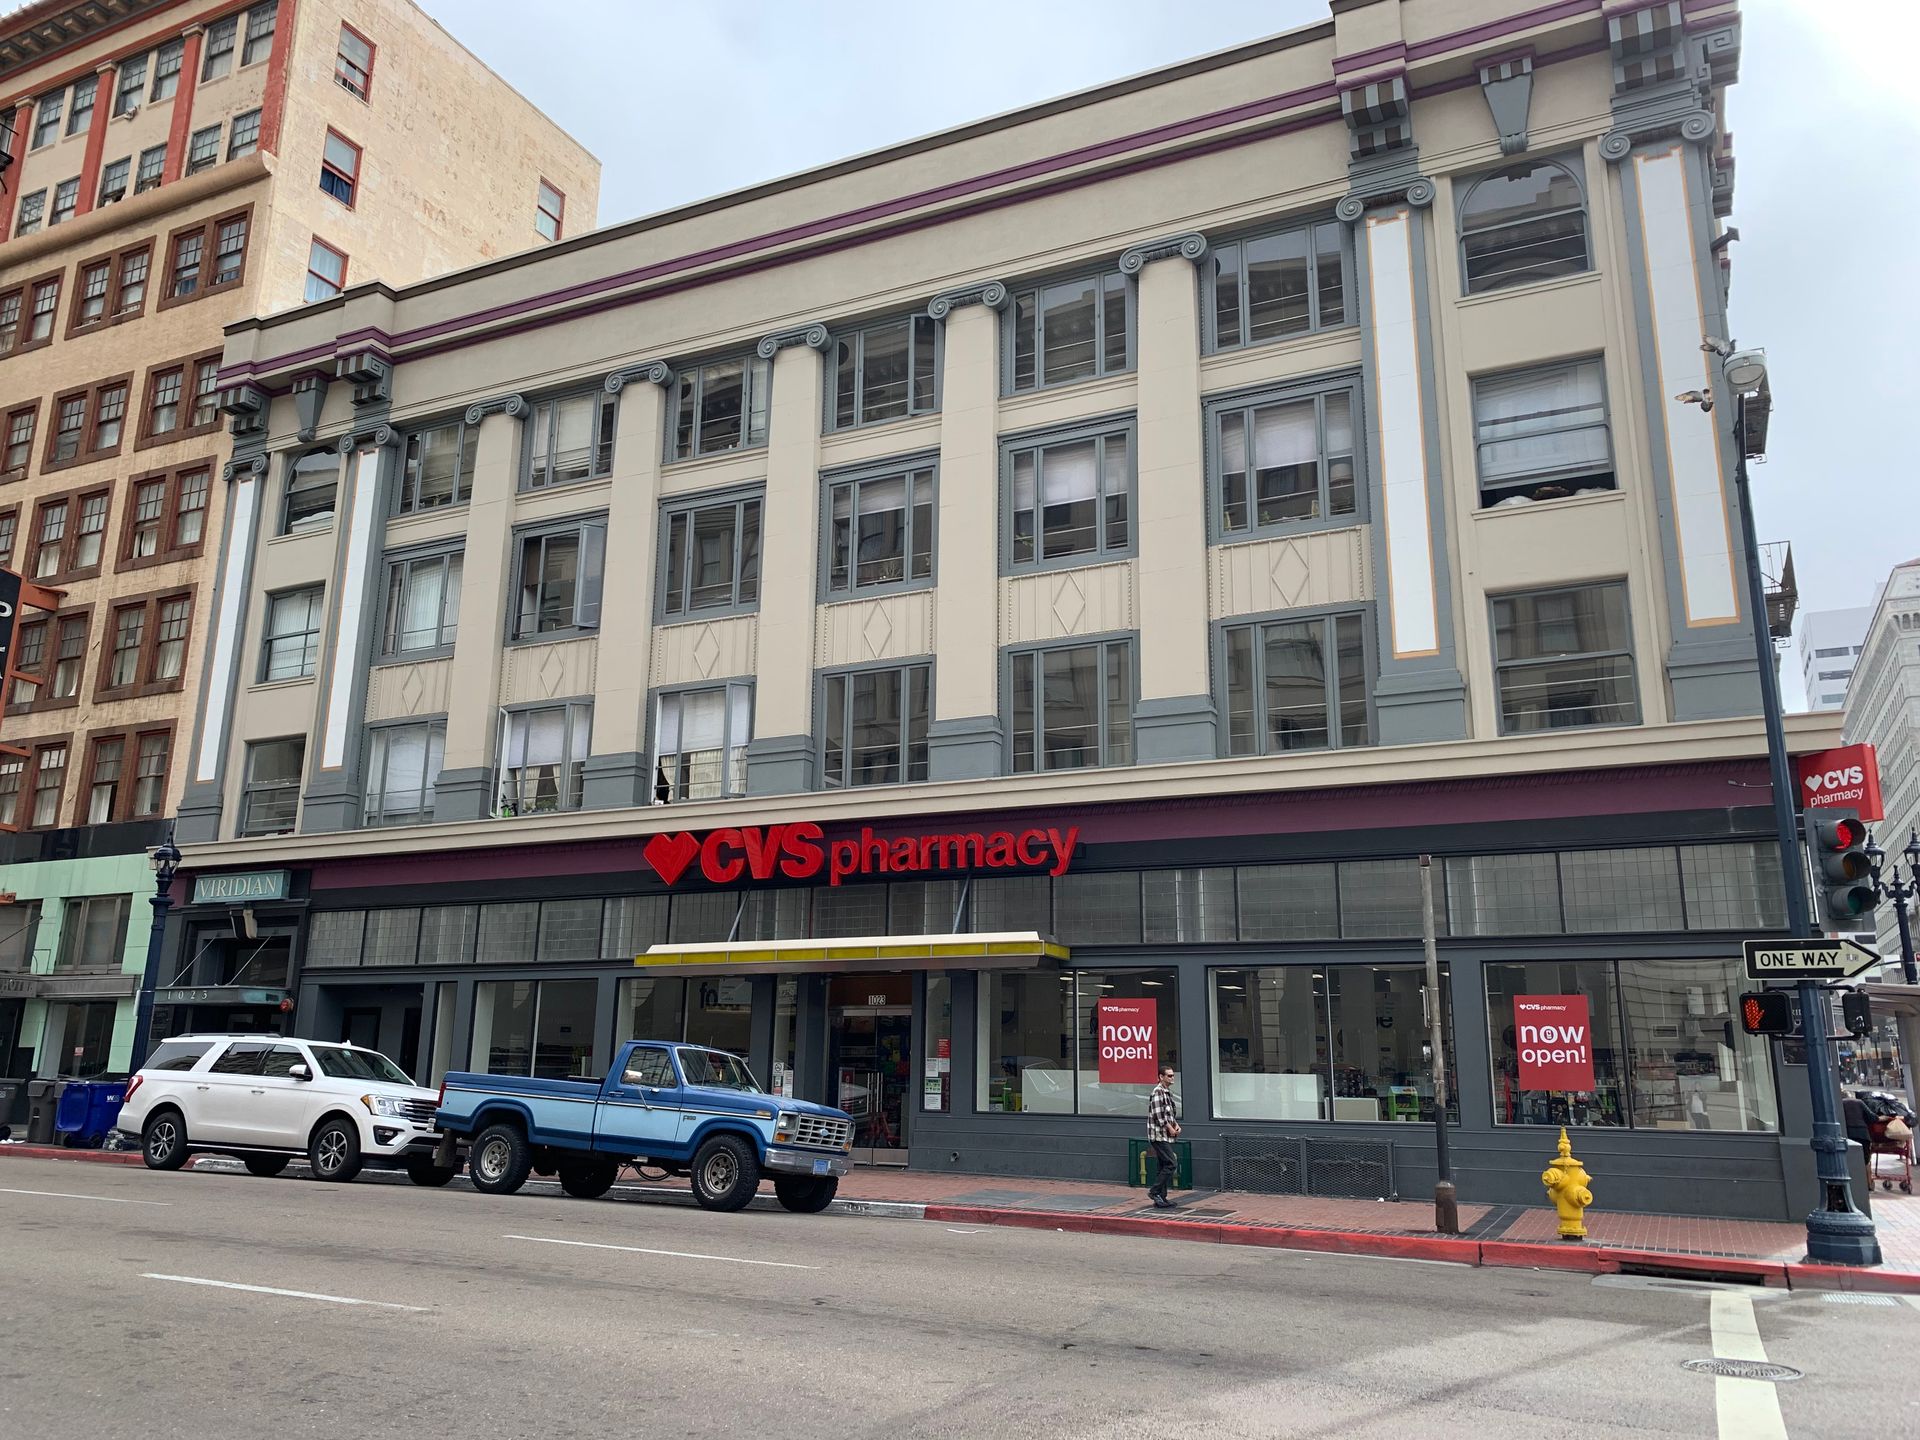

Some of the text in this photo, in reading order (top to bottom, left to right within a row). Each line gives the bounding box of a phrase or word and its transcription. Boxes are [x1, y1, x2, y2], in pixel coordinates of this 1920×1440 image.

[1824, 765, 1863, 789] CVS
[1810, 788, 1864, 809] pharmacy
[700, 822, 1080, 887] CVS pharmacy
[200, 875, 277, 897] VIRIDIAN
[1760, 952, 1796, 967] ONE
[1801, 951, 1838, 966] WAY
[167, 991, 208, 1000] 1023
[868, 995, 886, 1005] 1023
[1102, 1025, 1153, 1042] now
[1520, 1025, 1584, 1044] now
[1102, 1043, 1153, 1063] open!
[1521, 1045, 1587, 1067] open!
